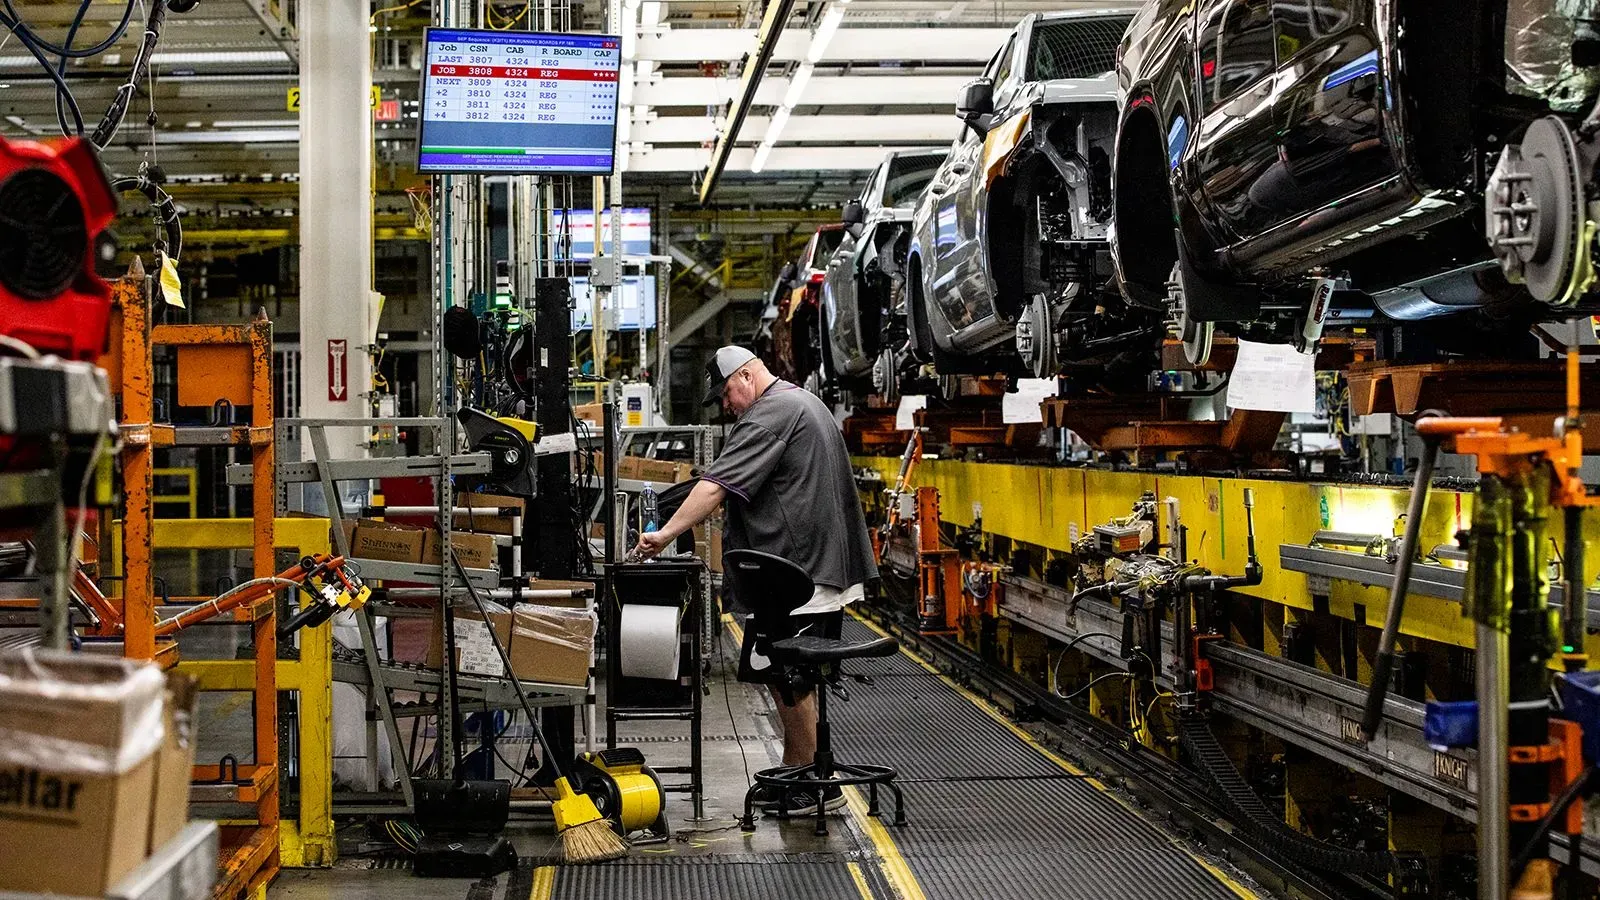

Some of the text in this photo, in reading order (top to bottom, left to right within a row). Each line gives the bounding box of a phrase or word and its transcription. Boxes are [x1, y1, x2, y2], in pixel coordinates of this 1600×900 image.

[439, 44, 457, 52] Job
[506, 46, 524, 54] CAB
[554, 48, 582, 56] BOARD
[469, 56, 492, 64] 3807
